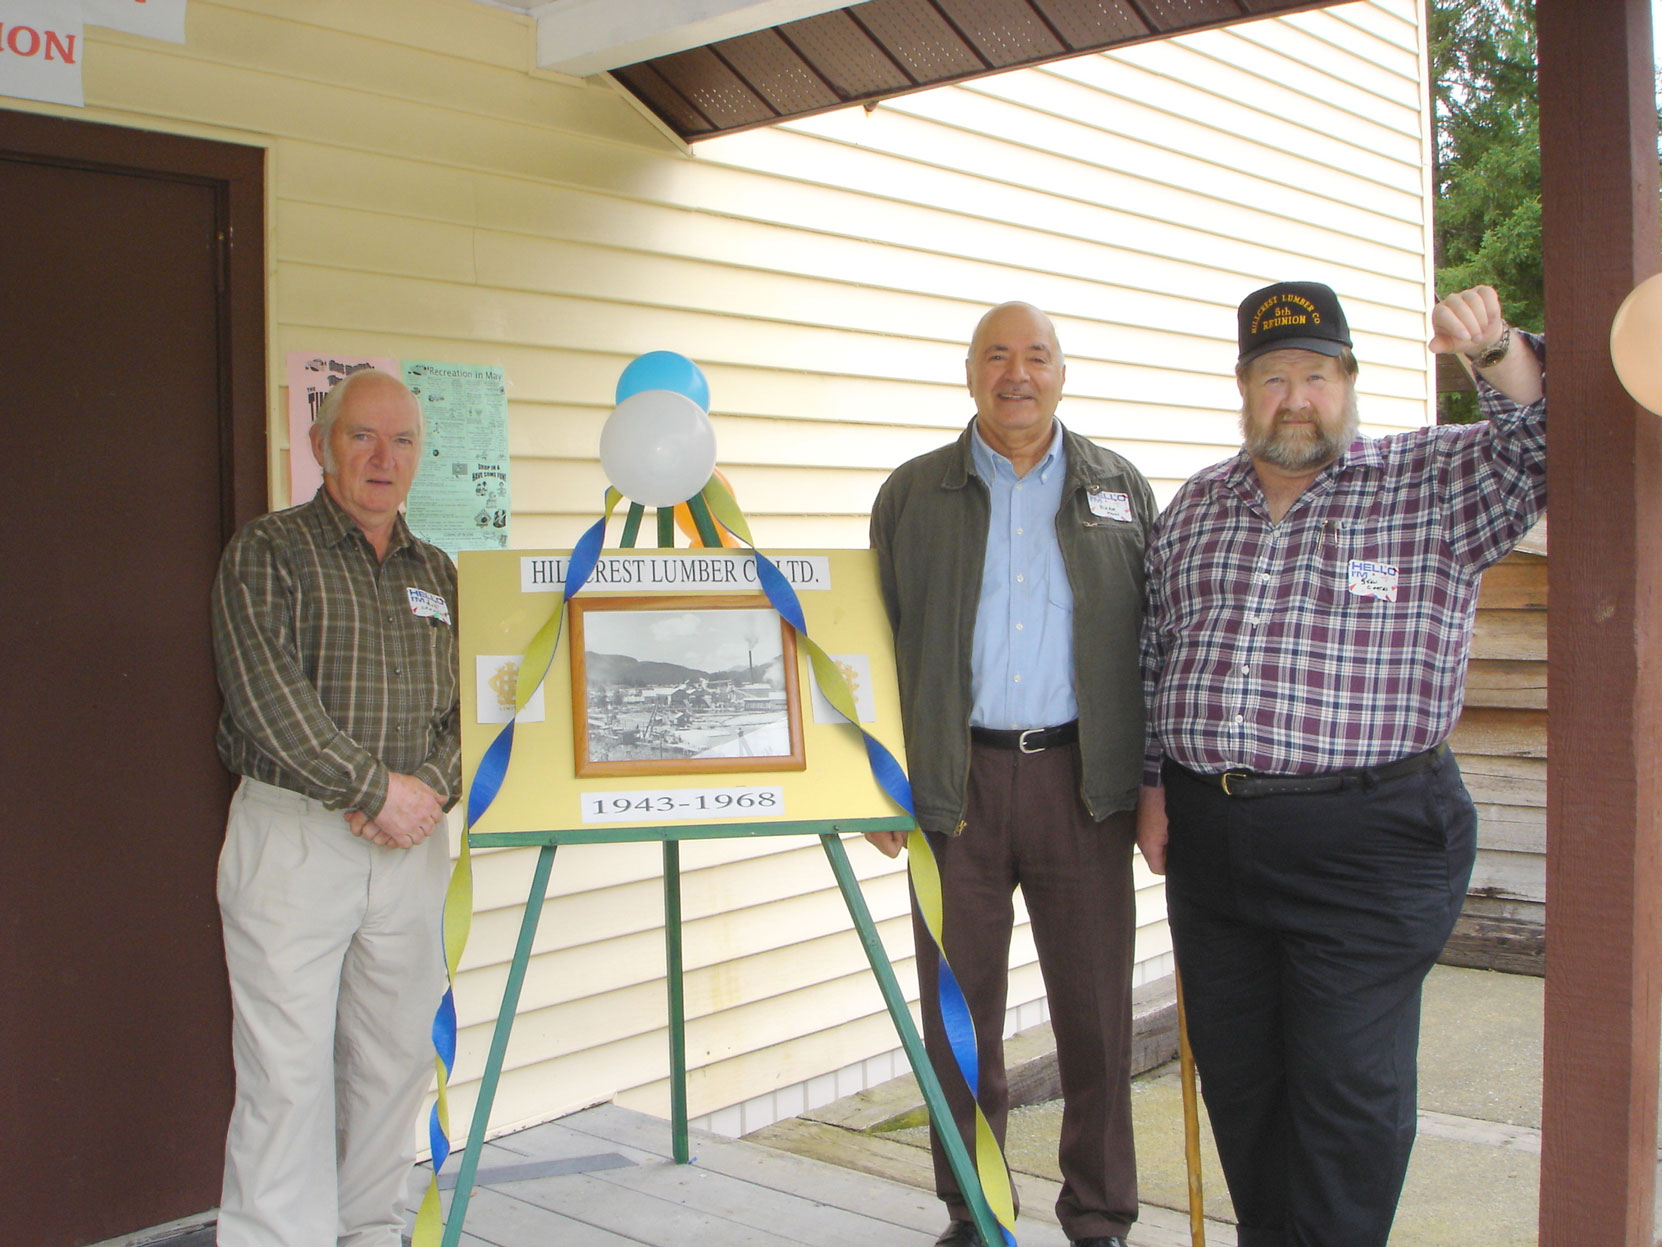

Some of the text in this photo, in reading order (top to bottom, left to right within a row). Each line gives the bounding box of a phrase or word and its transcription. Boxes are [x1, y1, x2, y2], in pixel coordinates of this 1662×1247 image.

[1251, 294, 1321, 334] HILLCREST LUMBER CO
[1274, 306, 1292, 316] 5th
[1262, 315, 1307, 330] REUNION
[429, 366, 502, 382] Recreation in May
[532, 559, 645, 584] HILREST
[651, 559, 738, 584] LUMBER
[1351, 561, 1396, 576] HELLO
[409, 588, 444, 605] HELLO
[593, 791, 777, 815] 1943-1968
